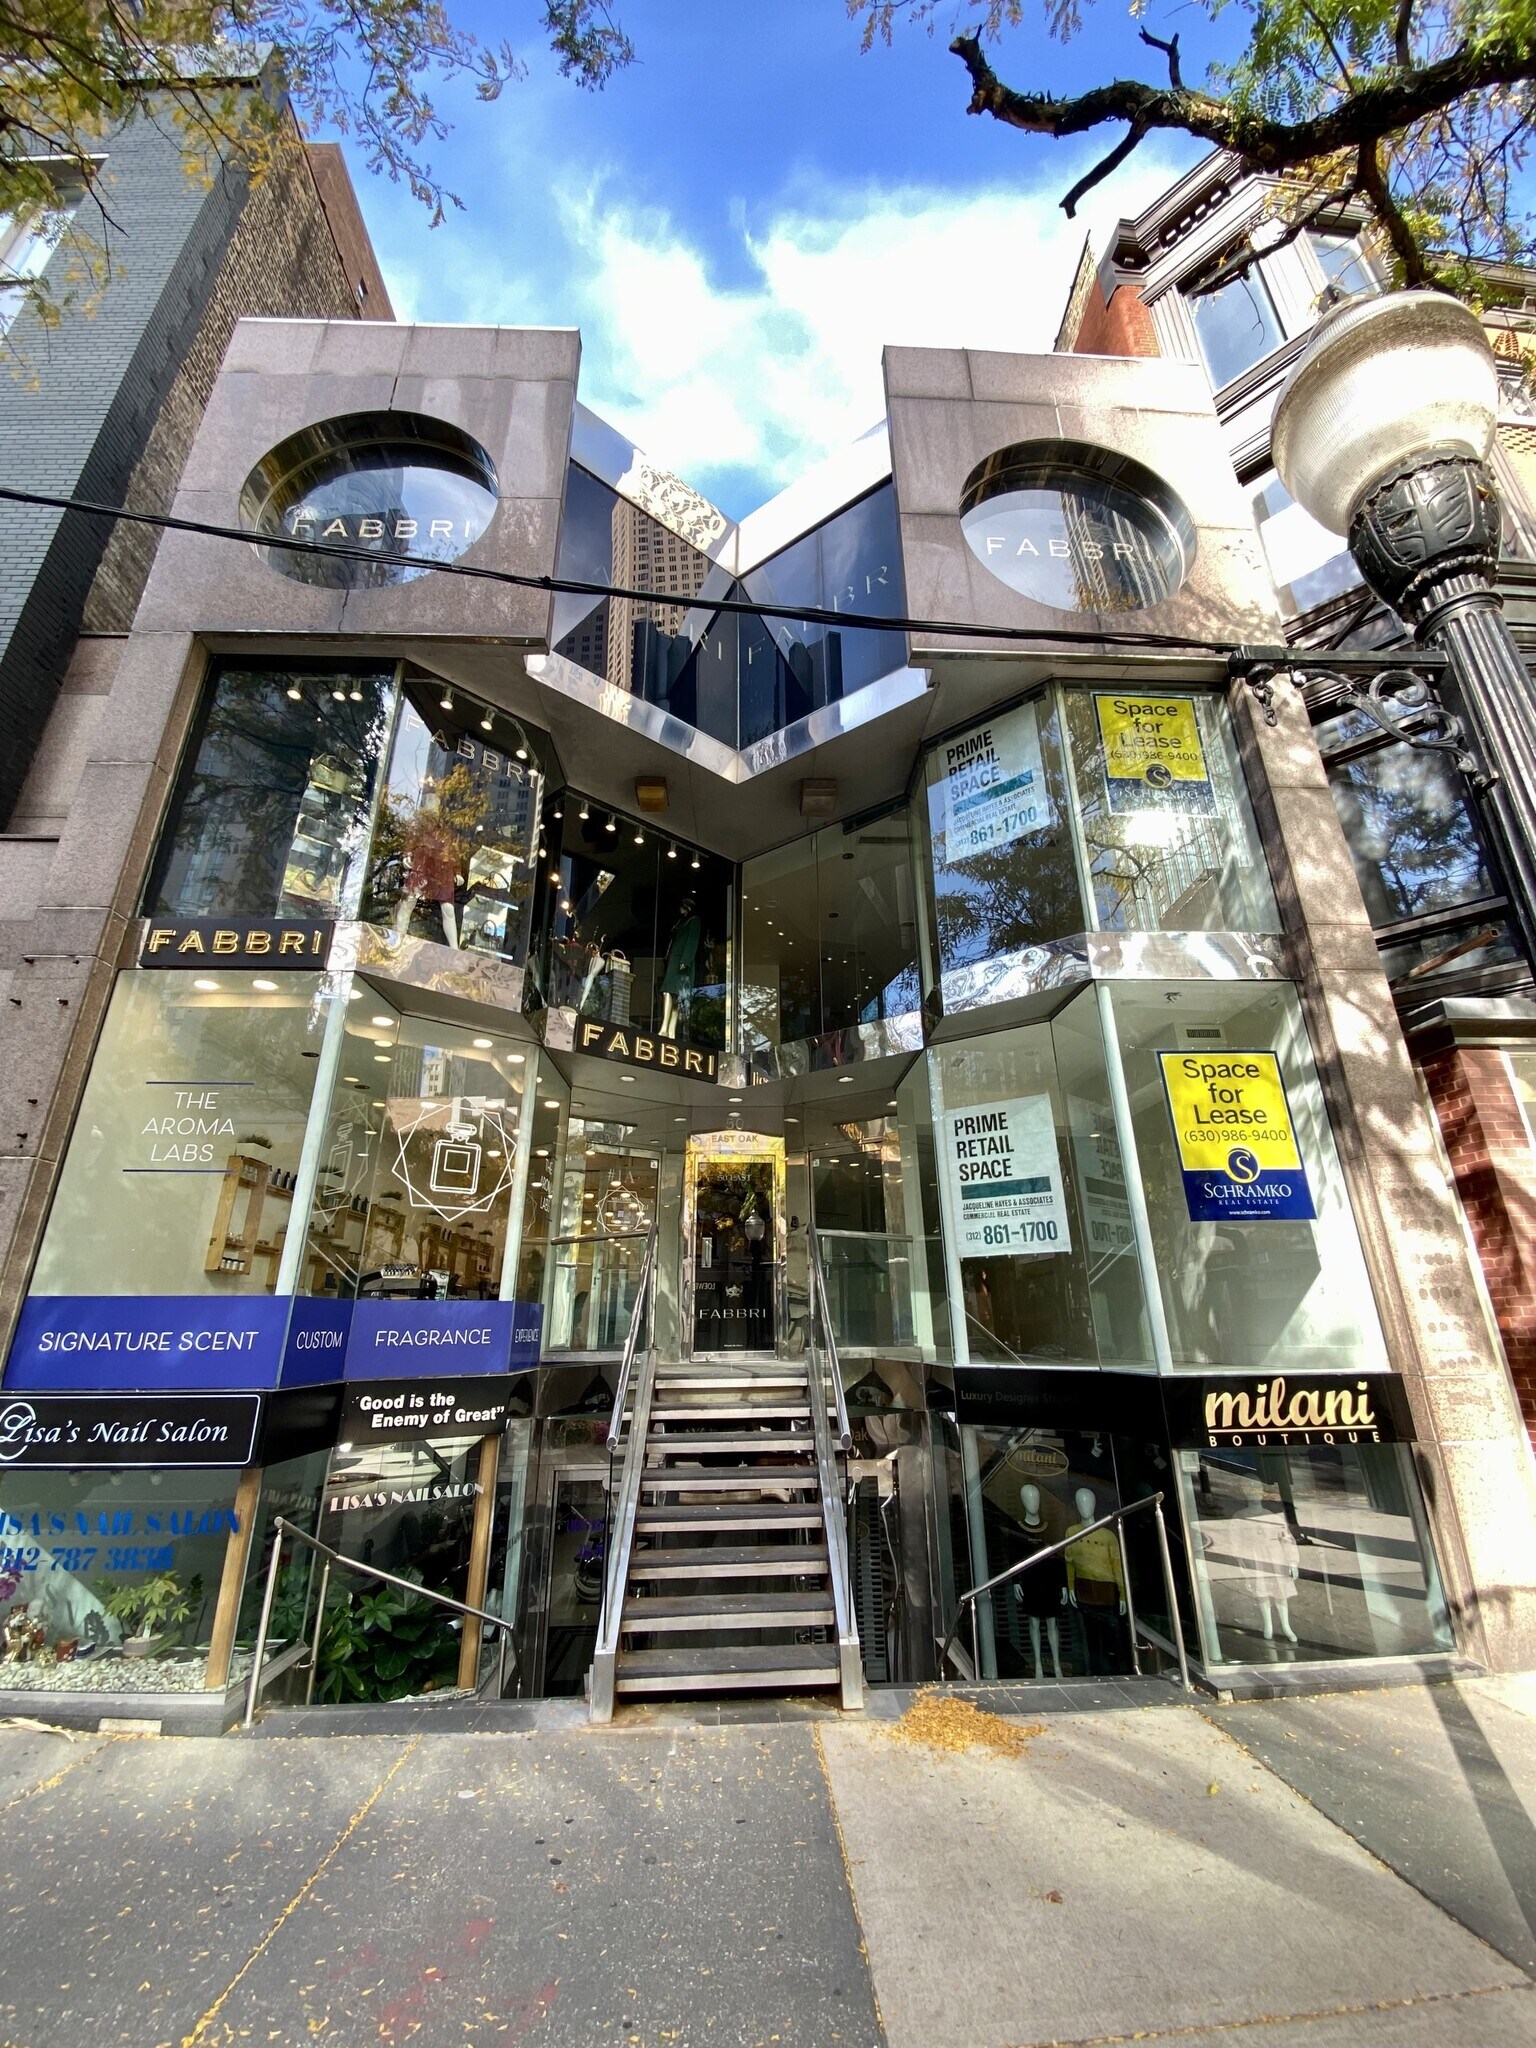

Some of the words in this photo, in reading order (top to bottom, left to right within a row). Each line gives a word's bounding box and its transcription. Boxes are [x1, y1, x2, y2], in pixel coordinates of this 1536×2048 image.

[291, 518, 473, 539] FABBRI
[986, 537, 1156, 562] FABBRI
[1113, 700, 1178, 719] Space
[1133, 717, 1164, 733] for
[946, 729, 993, 766] PRIME
[1120, 732, 1182, 749] Lease
[405, 716, 536, 789] FABBRI
[948, 747, 1000, 784] RETAIL
[951, 765, 1000, 801] SPACE
[970, 806, 1037, 845] 861-1700
[147, 929, 321, 954] FABBRI
[582, 1023, 715, 1076] FABBRI
[1184, 1059, 1260, 1083] Space
[174, 1091, 219, 1111] THE
[1208, 1082, 1244, 1104] for
[726, 1118, 744, 1130] 50
[954, 1112, 1008, 1137] PRIME
[1194, 1104, 1267, 1125] Lease
[142, 1117, 236, 1136] AROMA
[1183, 1128, 1287, 1144] (630)986-9400
[712, 1135, 735, 1143] EAST
[738, 1135, 758, 1143] OAK
[956, 1136, 1015, 1159] RETAIL
[150, 1143, 214, 1162] LABS
[959, 1159, 1013, 1182] SPACE
[1204, 1183, 1292, 1198] SCHRAMKO
[963, 1201, 994, 1211] JACQUELINE
[995, 1199, 1012, 1207] HAYES
[1018, 1196, 1053, 1205] ASSOCIATES
[963, 1211, 995, 1220] COMMERCIAL
[1011, 1208, 1031, 1216] ESTATE
[965, 1231, 981, 1241] (312)
[983, 1220, 1058, 1245] 861-1700
[700, 1308, 766, 1319] FABBRI
[38, 1332, 171, 1352] SIGNATURE
[177, 1330, 260, 1351] SCENT
[296, 1331, 342, 1349] CUSTOM
[375, 1329, 491, 1347] FRAGRANCE
[409, 1394, 425, 1408] is
[429, 1392, 456, 1407] the
[960, 1390, 993, 1403] Luxury
[1205, 1377, 1376, 1428] milani
[371, 1412, 429, 1429] Enemy
[433, 1410, 450, 1424] of
[87, 1419, 150, 1443] Nail
[156, 1419, 229, 1443] Salon
[1208, 1431, 1381, 1447] BOUTIQUE
[330, 1491, 387, 1512] LISA'S
[74, 1511, 136, 1536] NAIL
[145, 1509, 244, 1535] SALON
